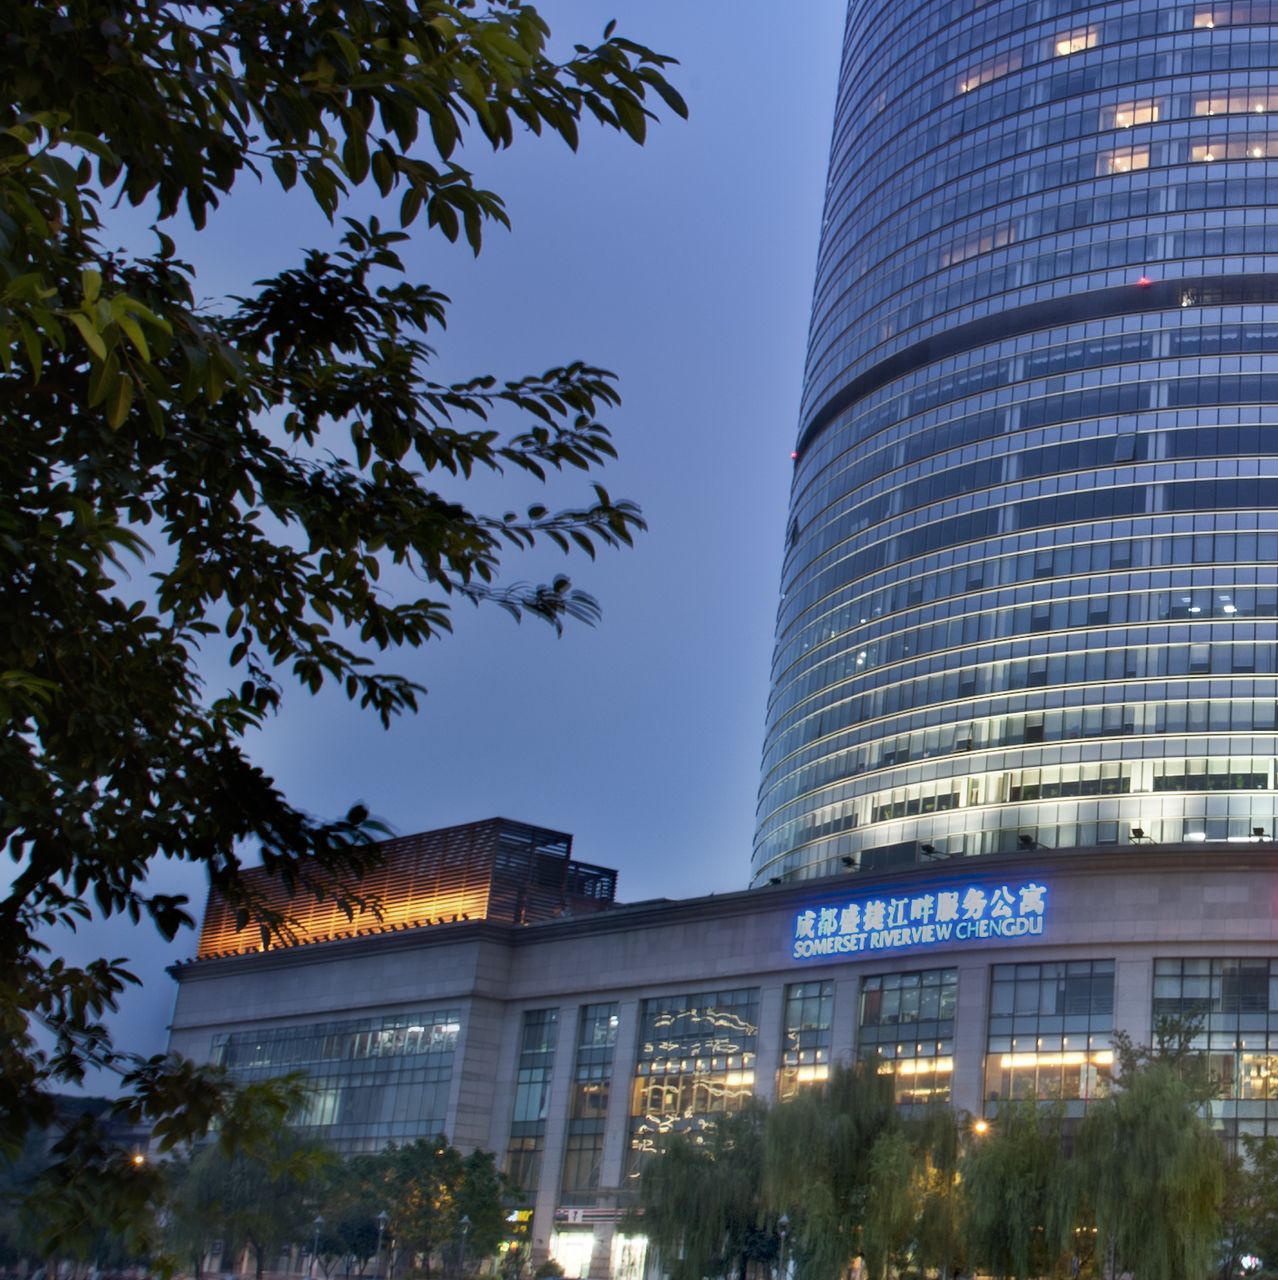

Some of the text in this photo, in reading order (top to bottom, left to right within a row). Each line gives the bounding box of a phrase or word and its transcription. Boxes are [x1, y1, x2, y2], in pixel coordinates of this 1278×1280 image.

[793, 916, 1043, 958] SOMERSET RIVERVIEW CHENGDU
